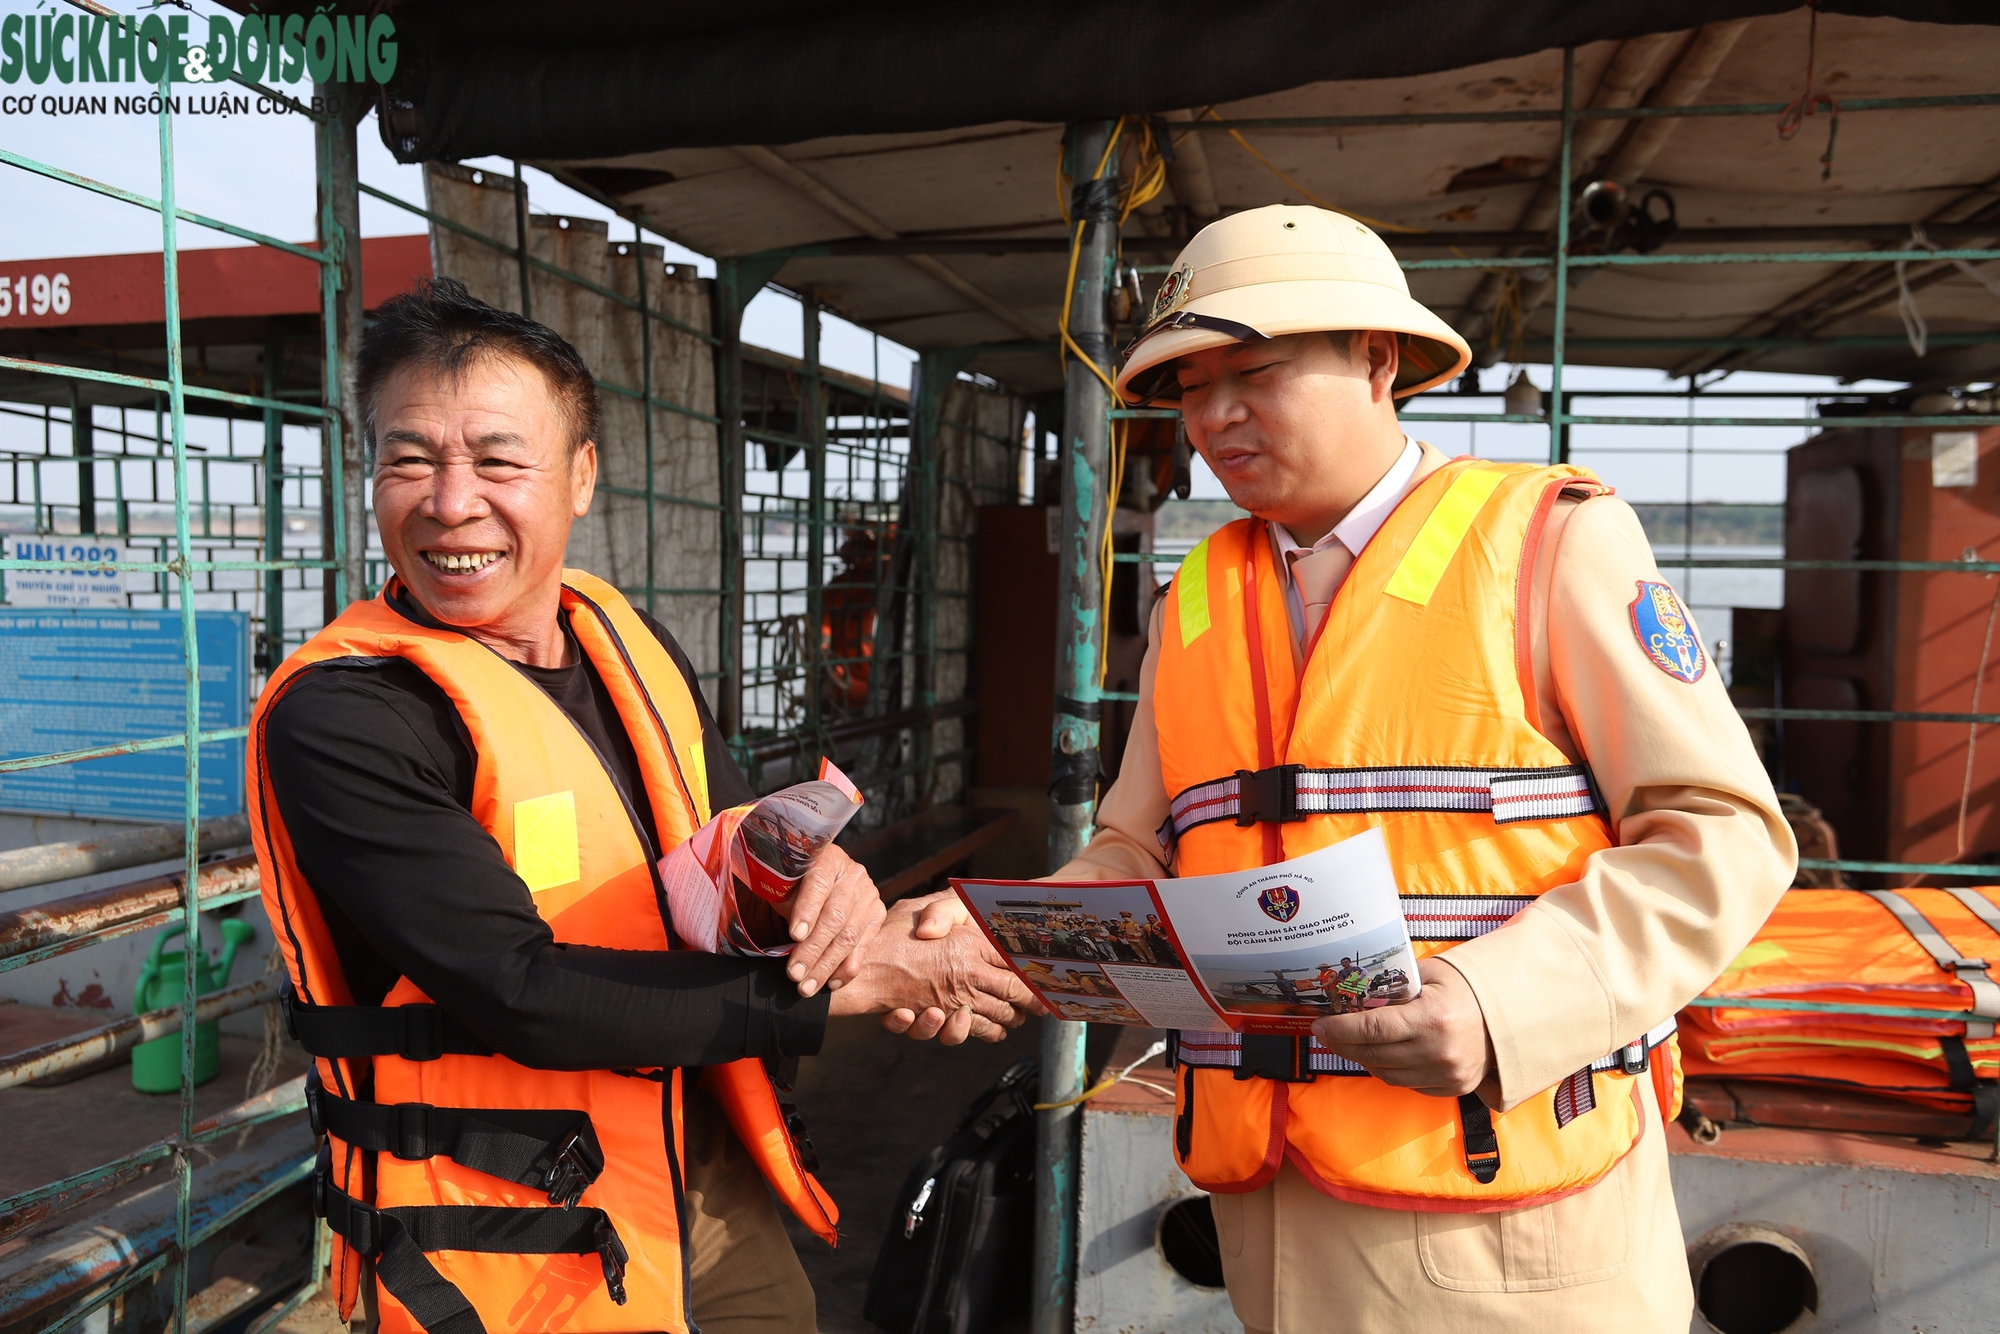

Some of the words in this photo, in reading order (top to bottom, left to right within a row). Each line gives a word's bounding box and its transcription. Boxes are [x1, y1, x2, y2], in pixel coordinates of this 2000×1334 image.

[1235, 886, 1249, 899] CÔNG
[1284, 930, 1315, 941] ĐƯỜNG
[1337, 919, 1349, 929] SỐ
[1299, 921, 1320, 930] GIAO
[1322, 912, 1350, 924] THÔNG
